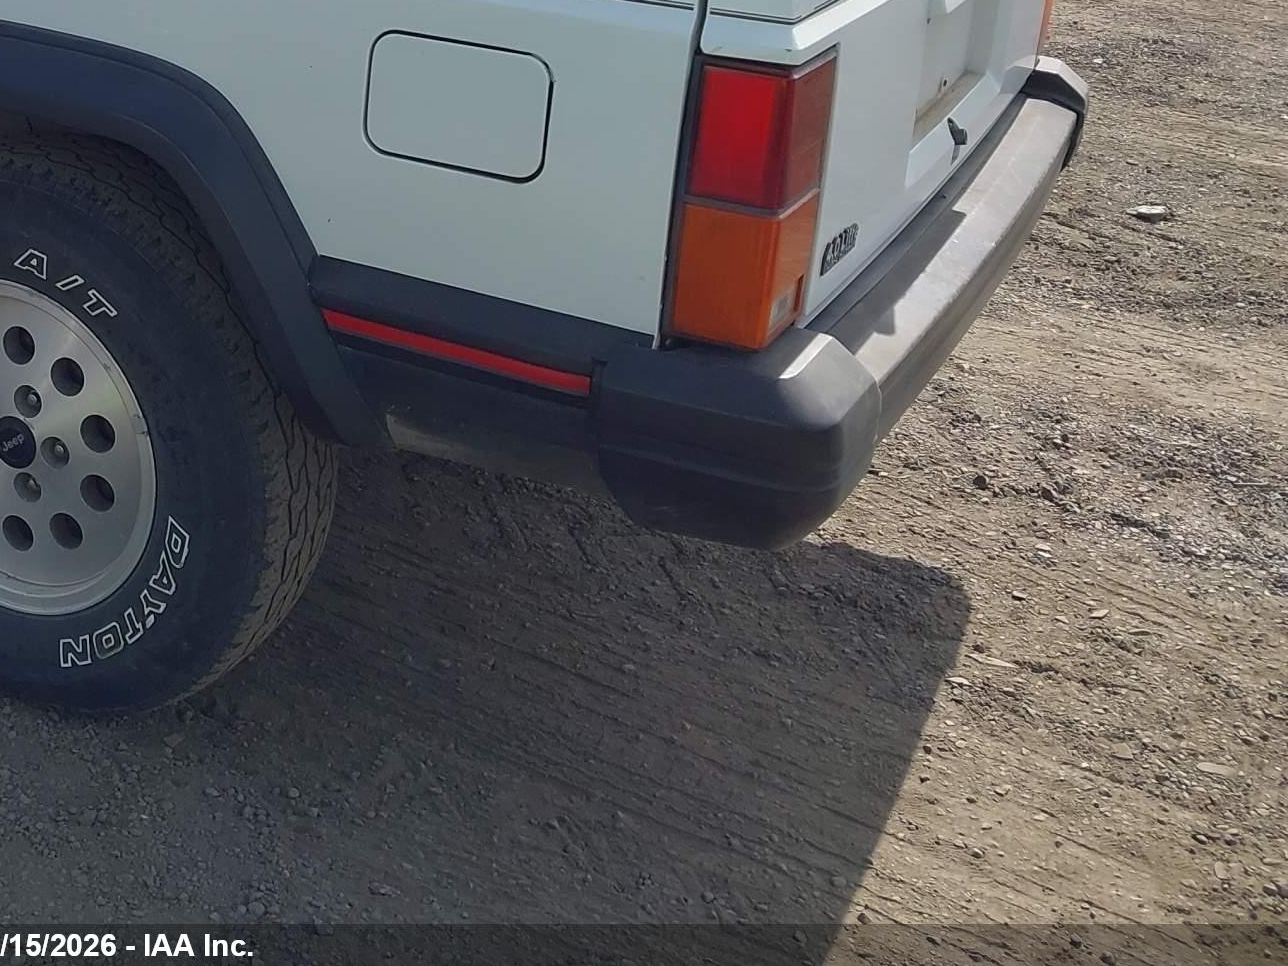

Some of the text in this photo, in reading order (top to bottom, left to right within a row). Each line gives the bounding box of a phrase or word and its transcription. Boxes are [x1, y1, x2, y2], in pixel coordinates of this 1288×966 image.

[13, 248, 118, 321] A/T
[2, 433, 25, 452] Jeep
[59, 515, 191, 668] DAYTON
